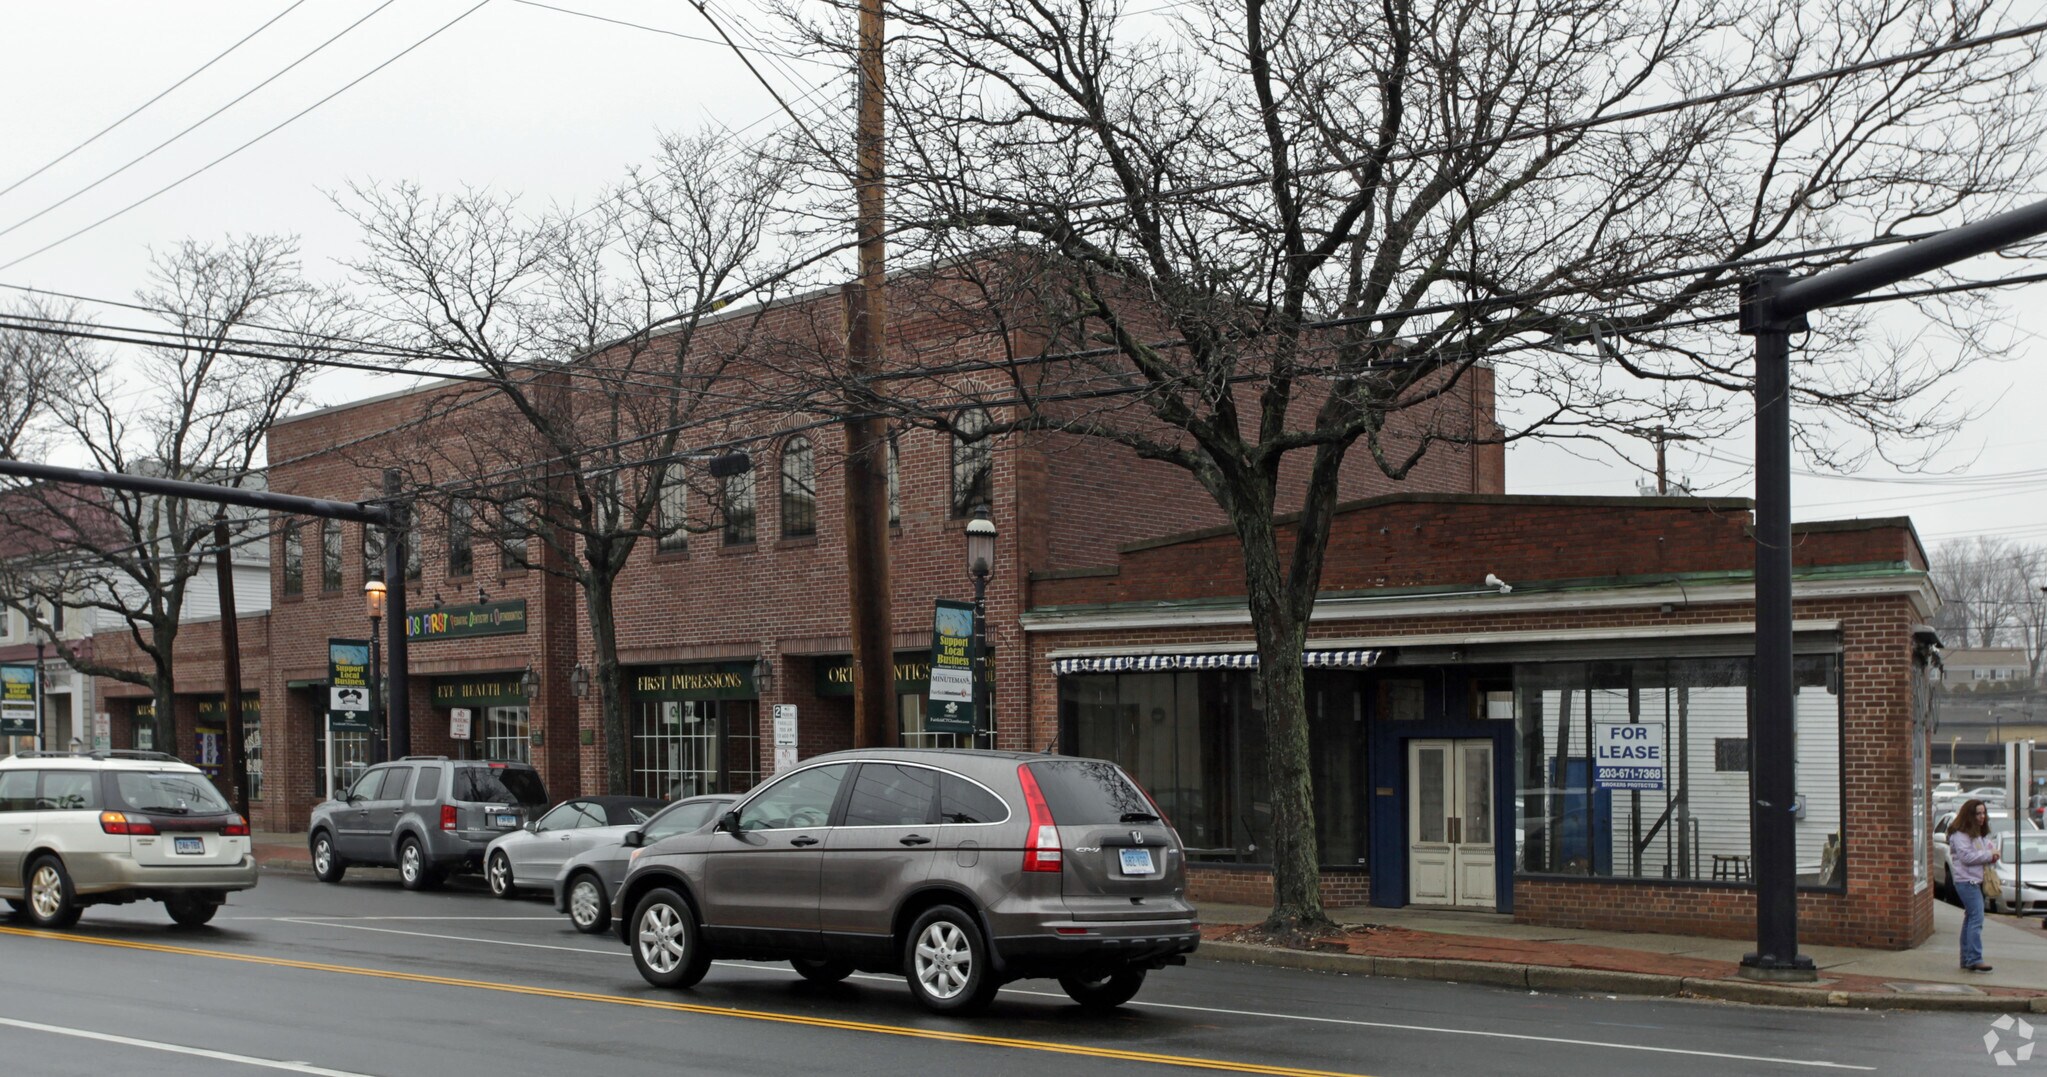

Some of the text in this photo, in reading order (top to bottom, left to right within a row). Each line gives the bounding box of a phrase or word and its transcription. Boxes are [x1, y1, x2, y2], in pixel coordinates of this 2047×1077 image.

[405, 615, 420, 637] IDS
[423, 612, 449, 634] FIRST
[940, 635, 969, 647] Support
[944, 646, 965, 656] Local
[937, 654, 970, 666] Business
[335, 664, 364, 673] Support
[335, 678, 366, 686] Business
[638, 673, 742, 691] FIRST IMPRESSIONS
[438, 685, 455, 698] EYE
[462, 683, 500, 697] HEALTH
[775, 706, 781, 717] 2
[1611, 727, 1647, 740] FOR
[206, 735, 214, 764] OPEN
[1599, 746, 1660, 759] LEASE
[1599, 768, 1661, 779] 203-671-7368
